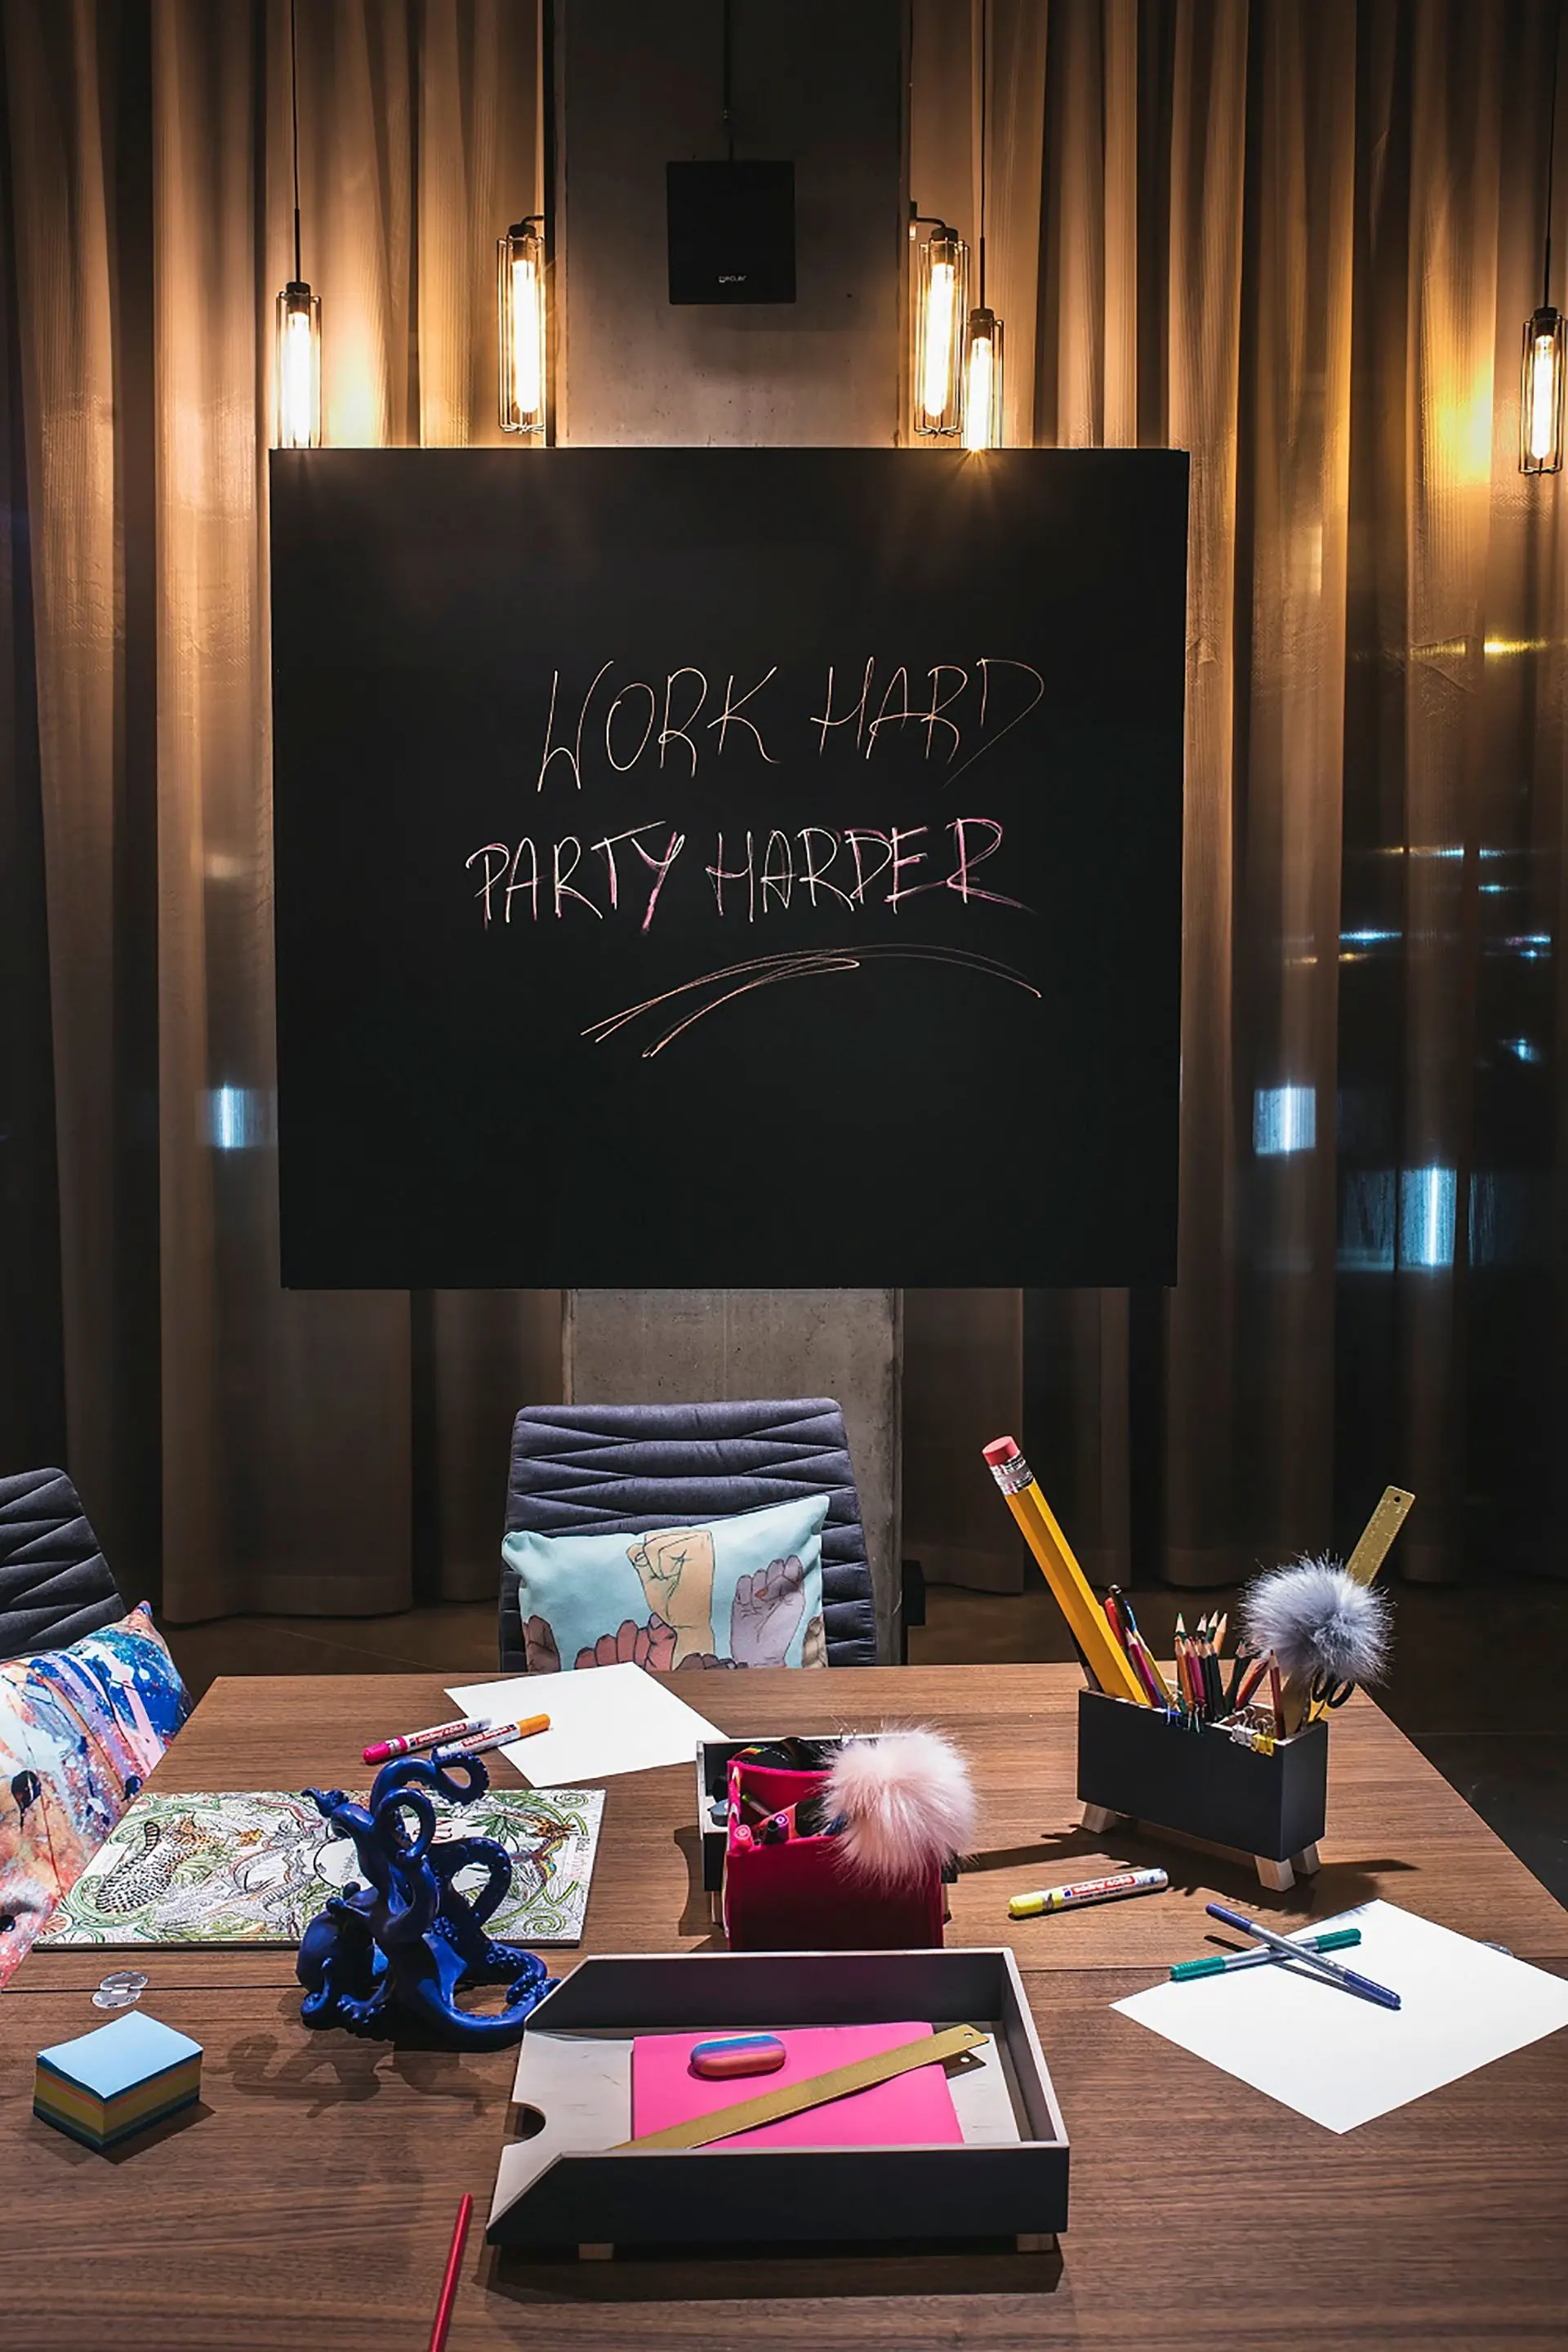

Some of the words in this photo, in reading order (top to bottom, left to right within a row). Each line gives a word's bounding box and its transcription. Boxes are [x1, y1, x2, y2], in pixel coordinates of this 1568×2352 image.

[537, 660, 778, 792] WORK
[810, 656, 1045, 786] HARD
[465, 820, 686, 932] PARTY
[705, 817, 1032, 924] HARDER
